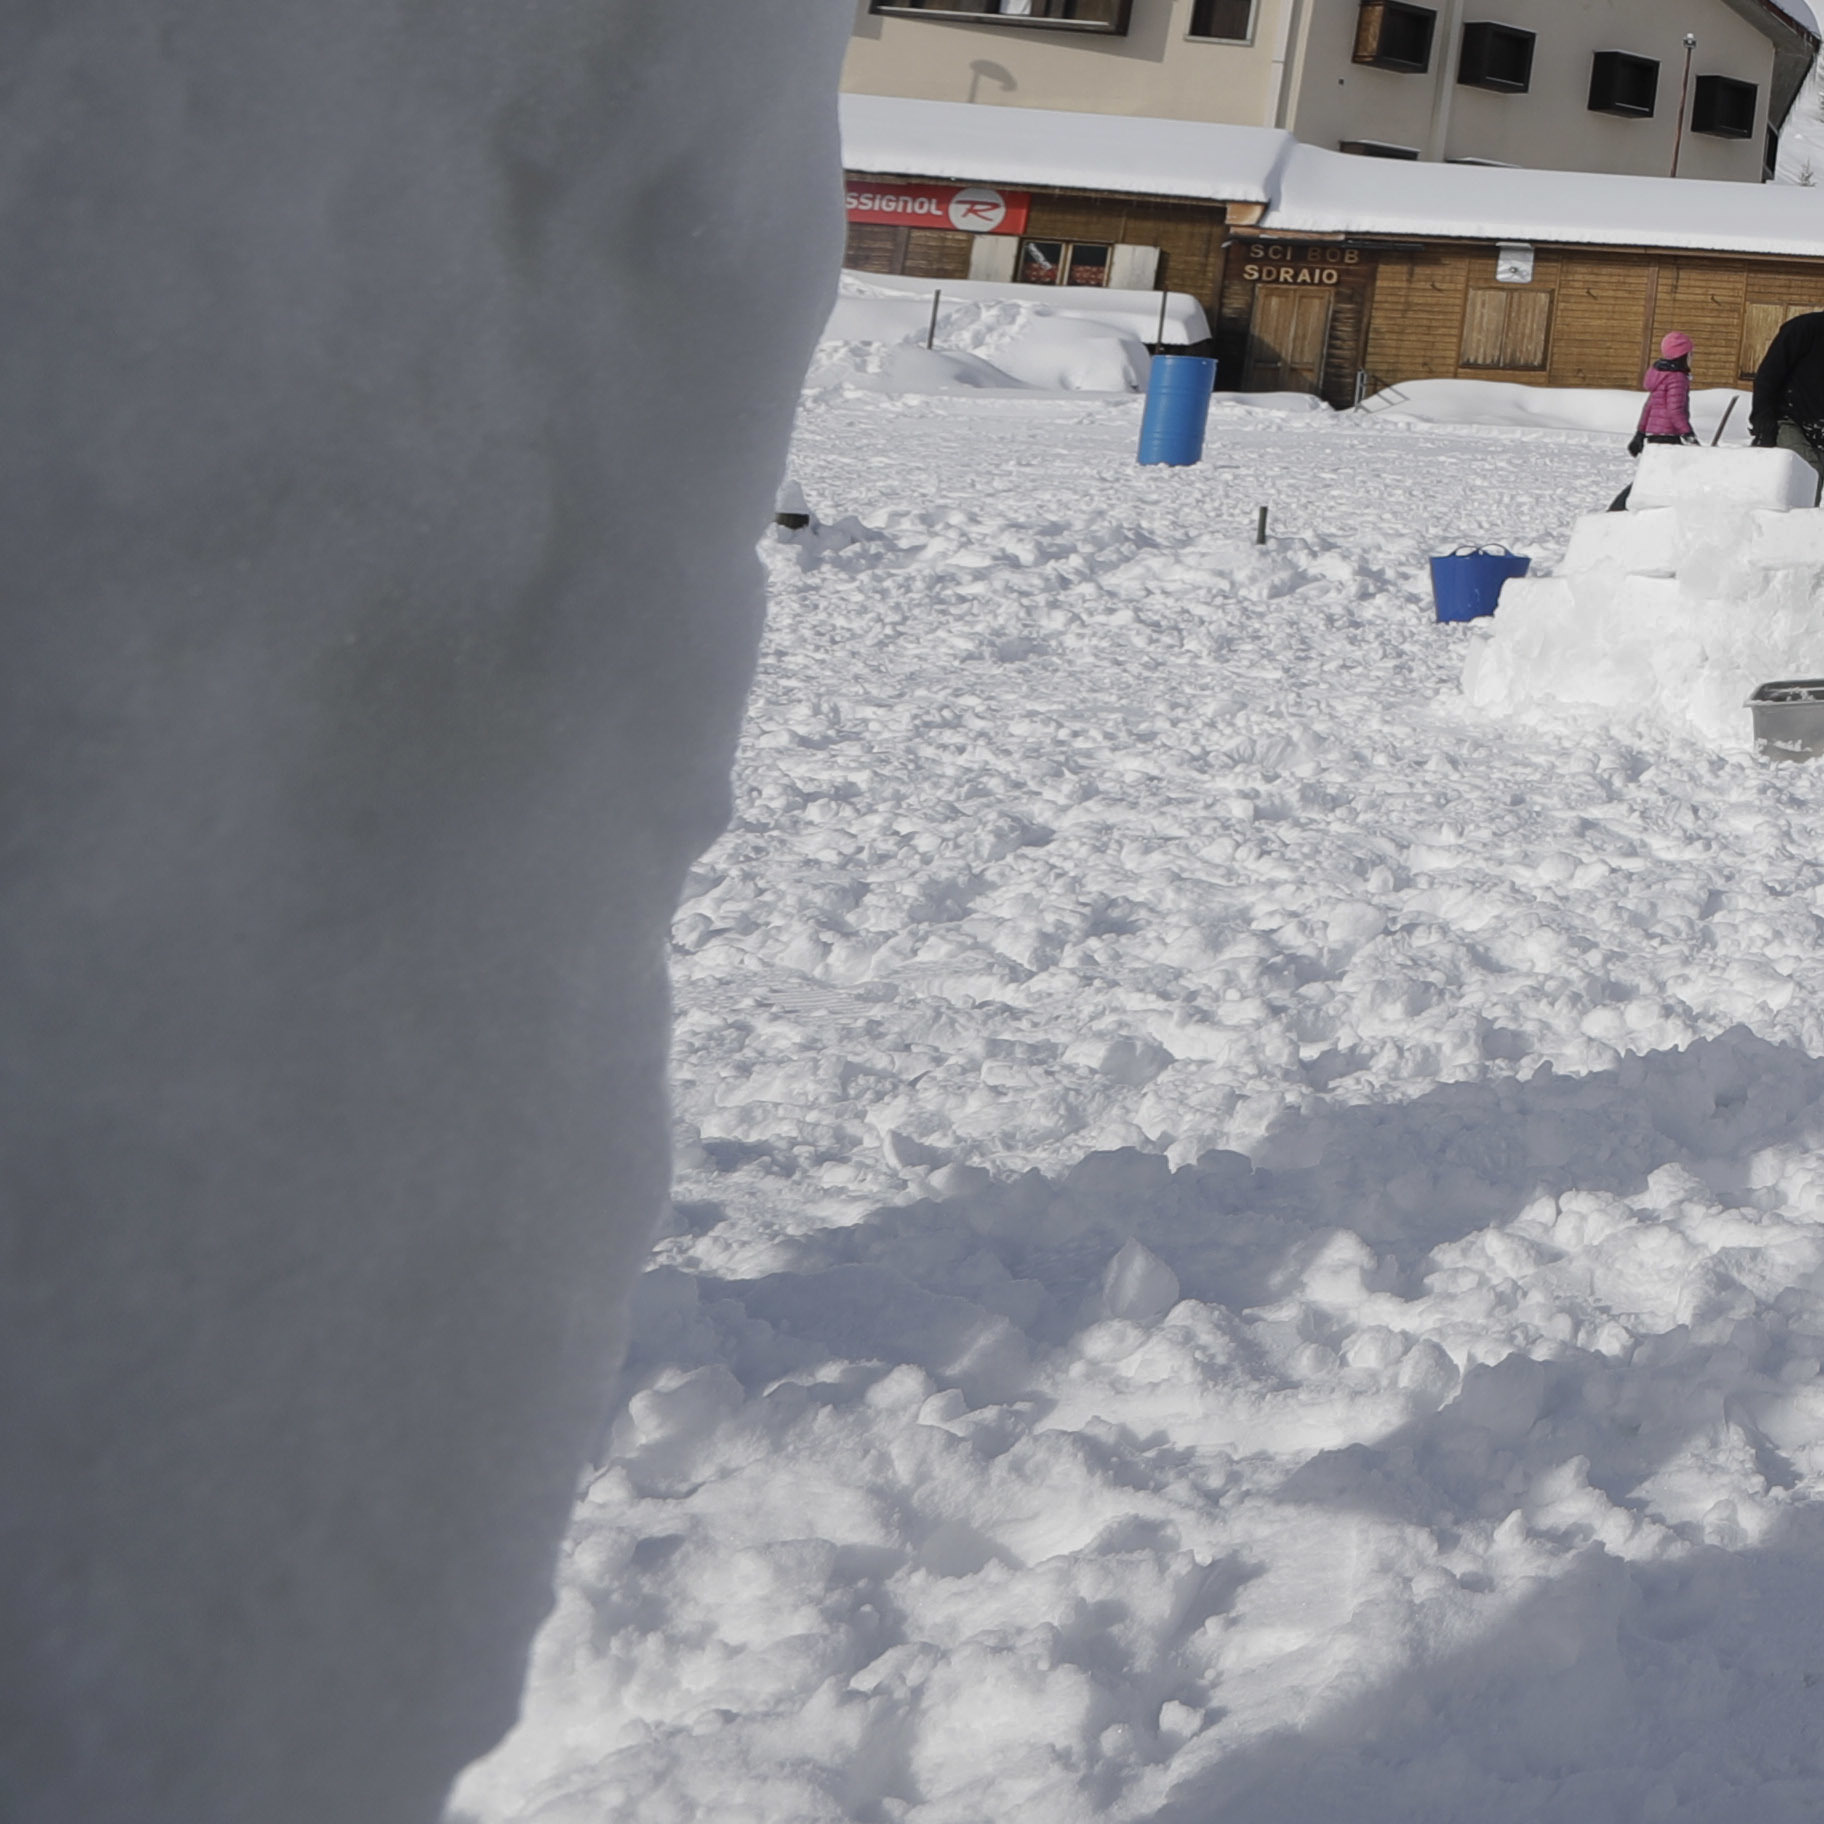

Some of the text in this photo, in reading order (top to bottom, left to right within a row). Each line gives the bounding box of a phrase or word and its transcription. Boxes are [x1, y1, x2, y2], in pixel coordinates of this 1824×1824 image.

[1250, 243, 1360, 264] SCI BOB
[1242, 264, 1339, 285] SDRAIO
